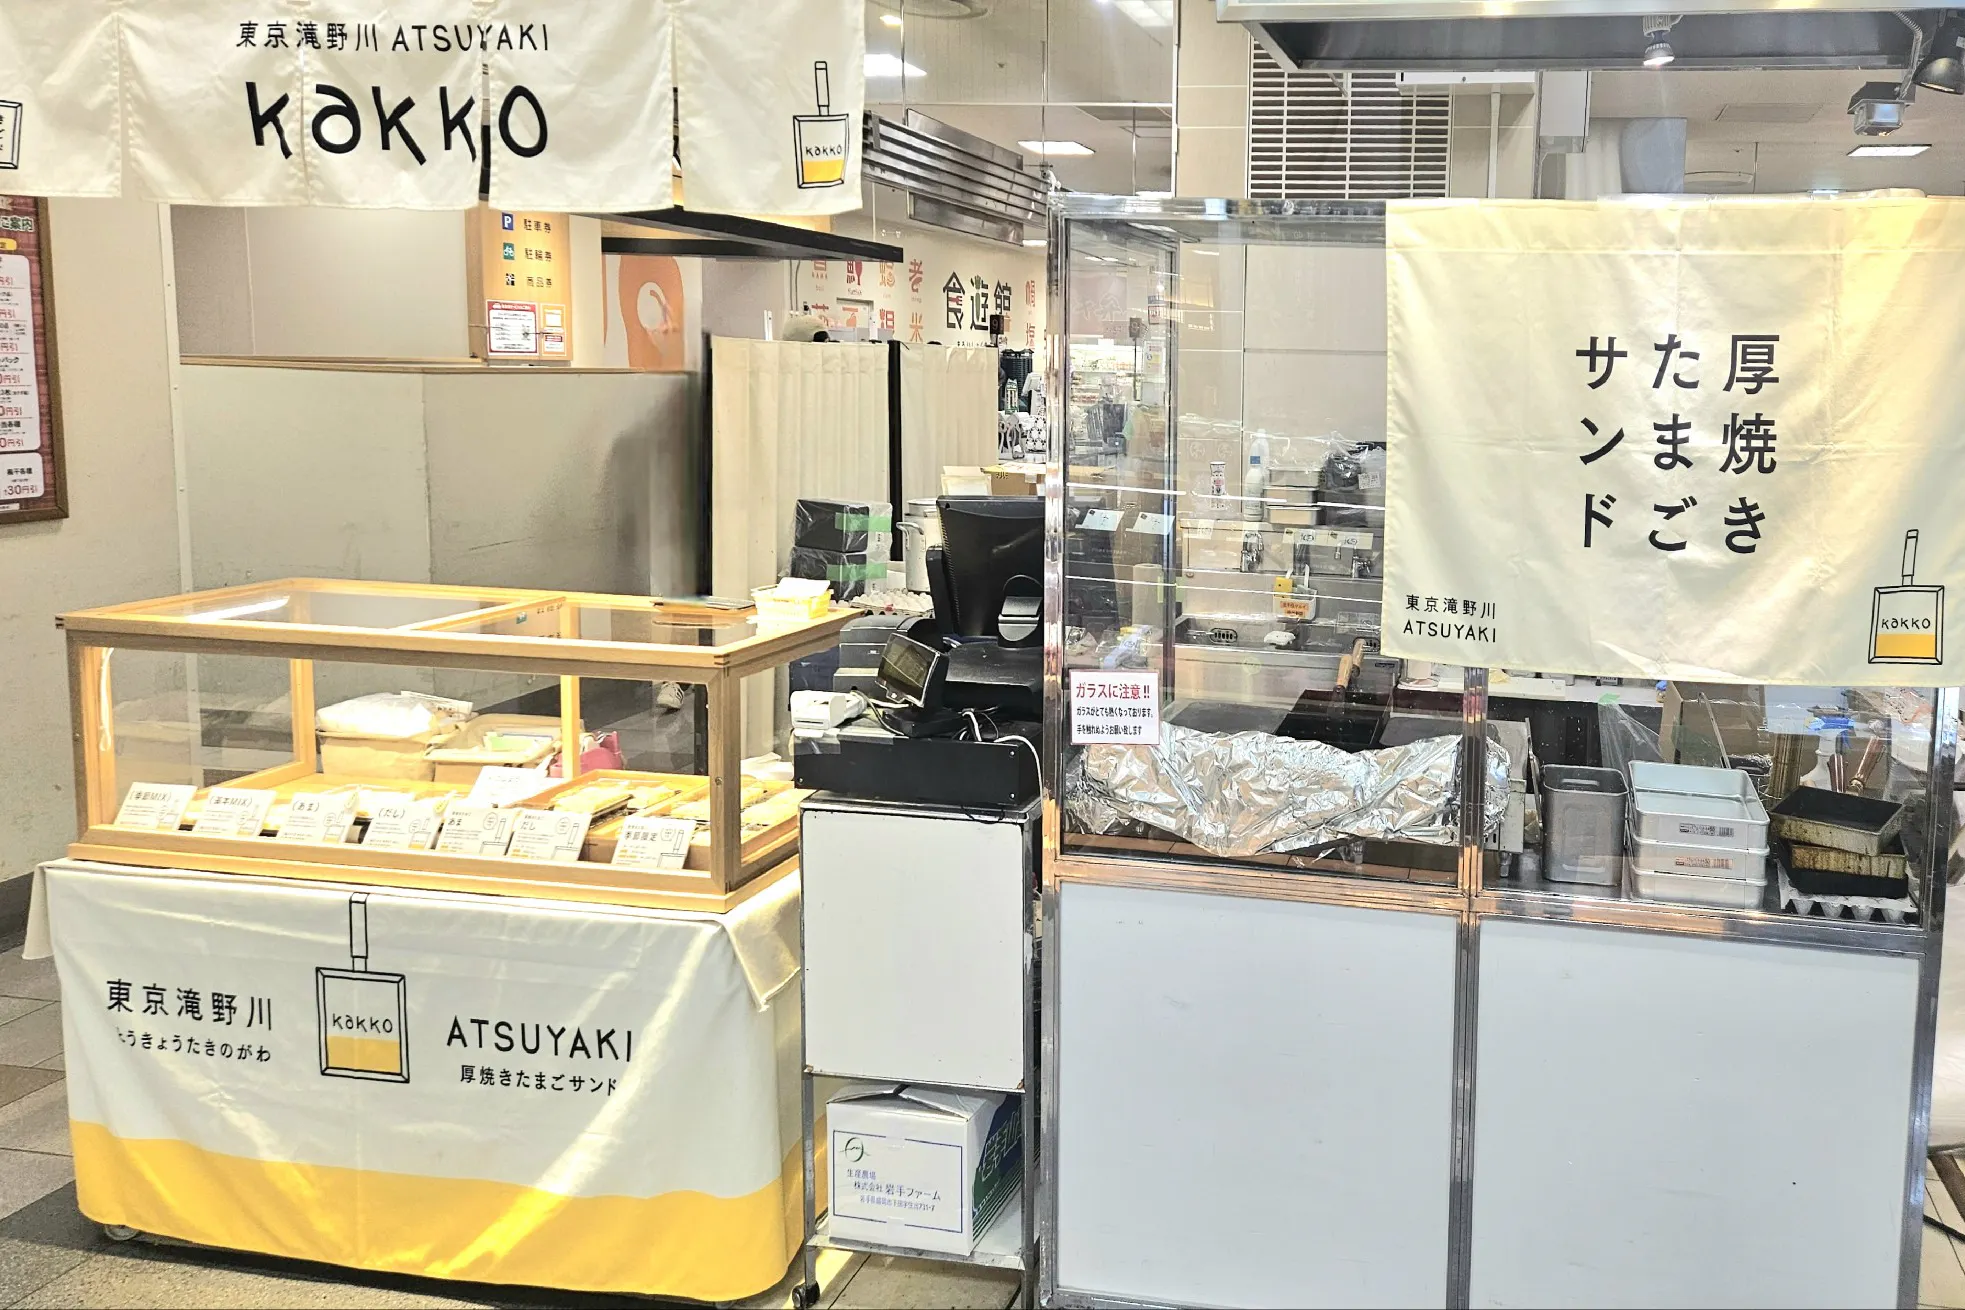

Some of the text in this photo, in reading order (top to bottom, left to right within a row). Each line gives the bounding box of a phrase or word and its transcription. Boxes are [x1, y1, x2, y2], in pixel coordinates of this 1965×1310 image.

[236, 20, 549, 52] 東京滝野川 ATSUYAKI
[1575, 336, 1628, 548] サンド
[1648, 333, 1701, 552] たまご
[1719, 334, 1780, 554] 厚焼き
[1403, 619, 1496, 643] ATSUYAKI
[1406, 594, 1496, 620] 東京滝野川
[107, 978, 272, 1031] 東京滝野川
[446, 1014, 632, 1063] ATSUYAKI
[460, 1063, 618, 1097] 厚焼きたまごサンド
